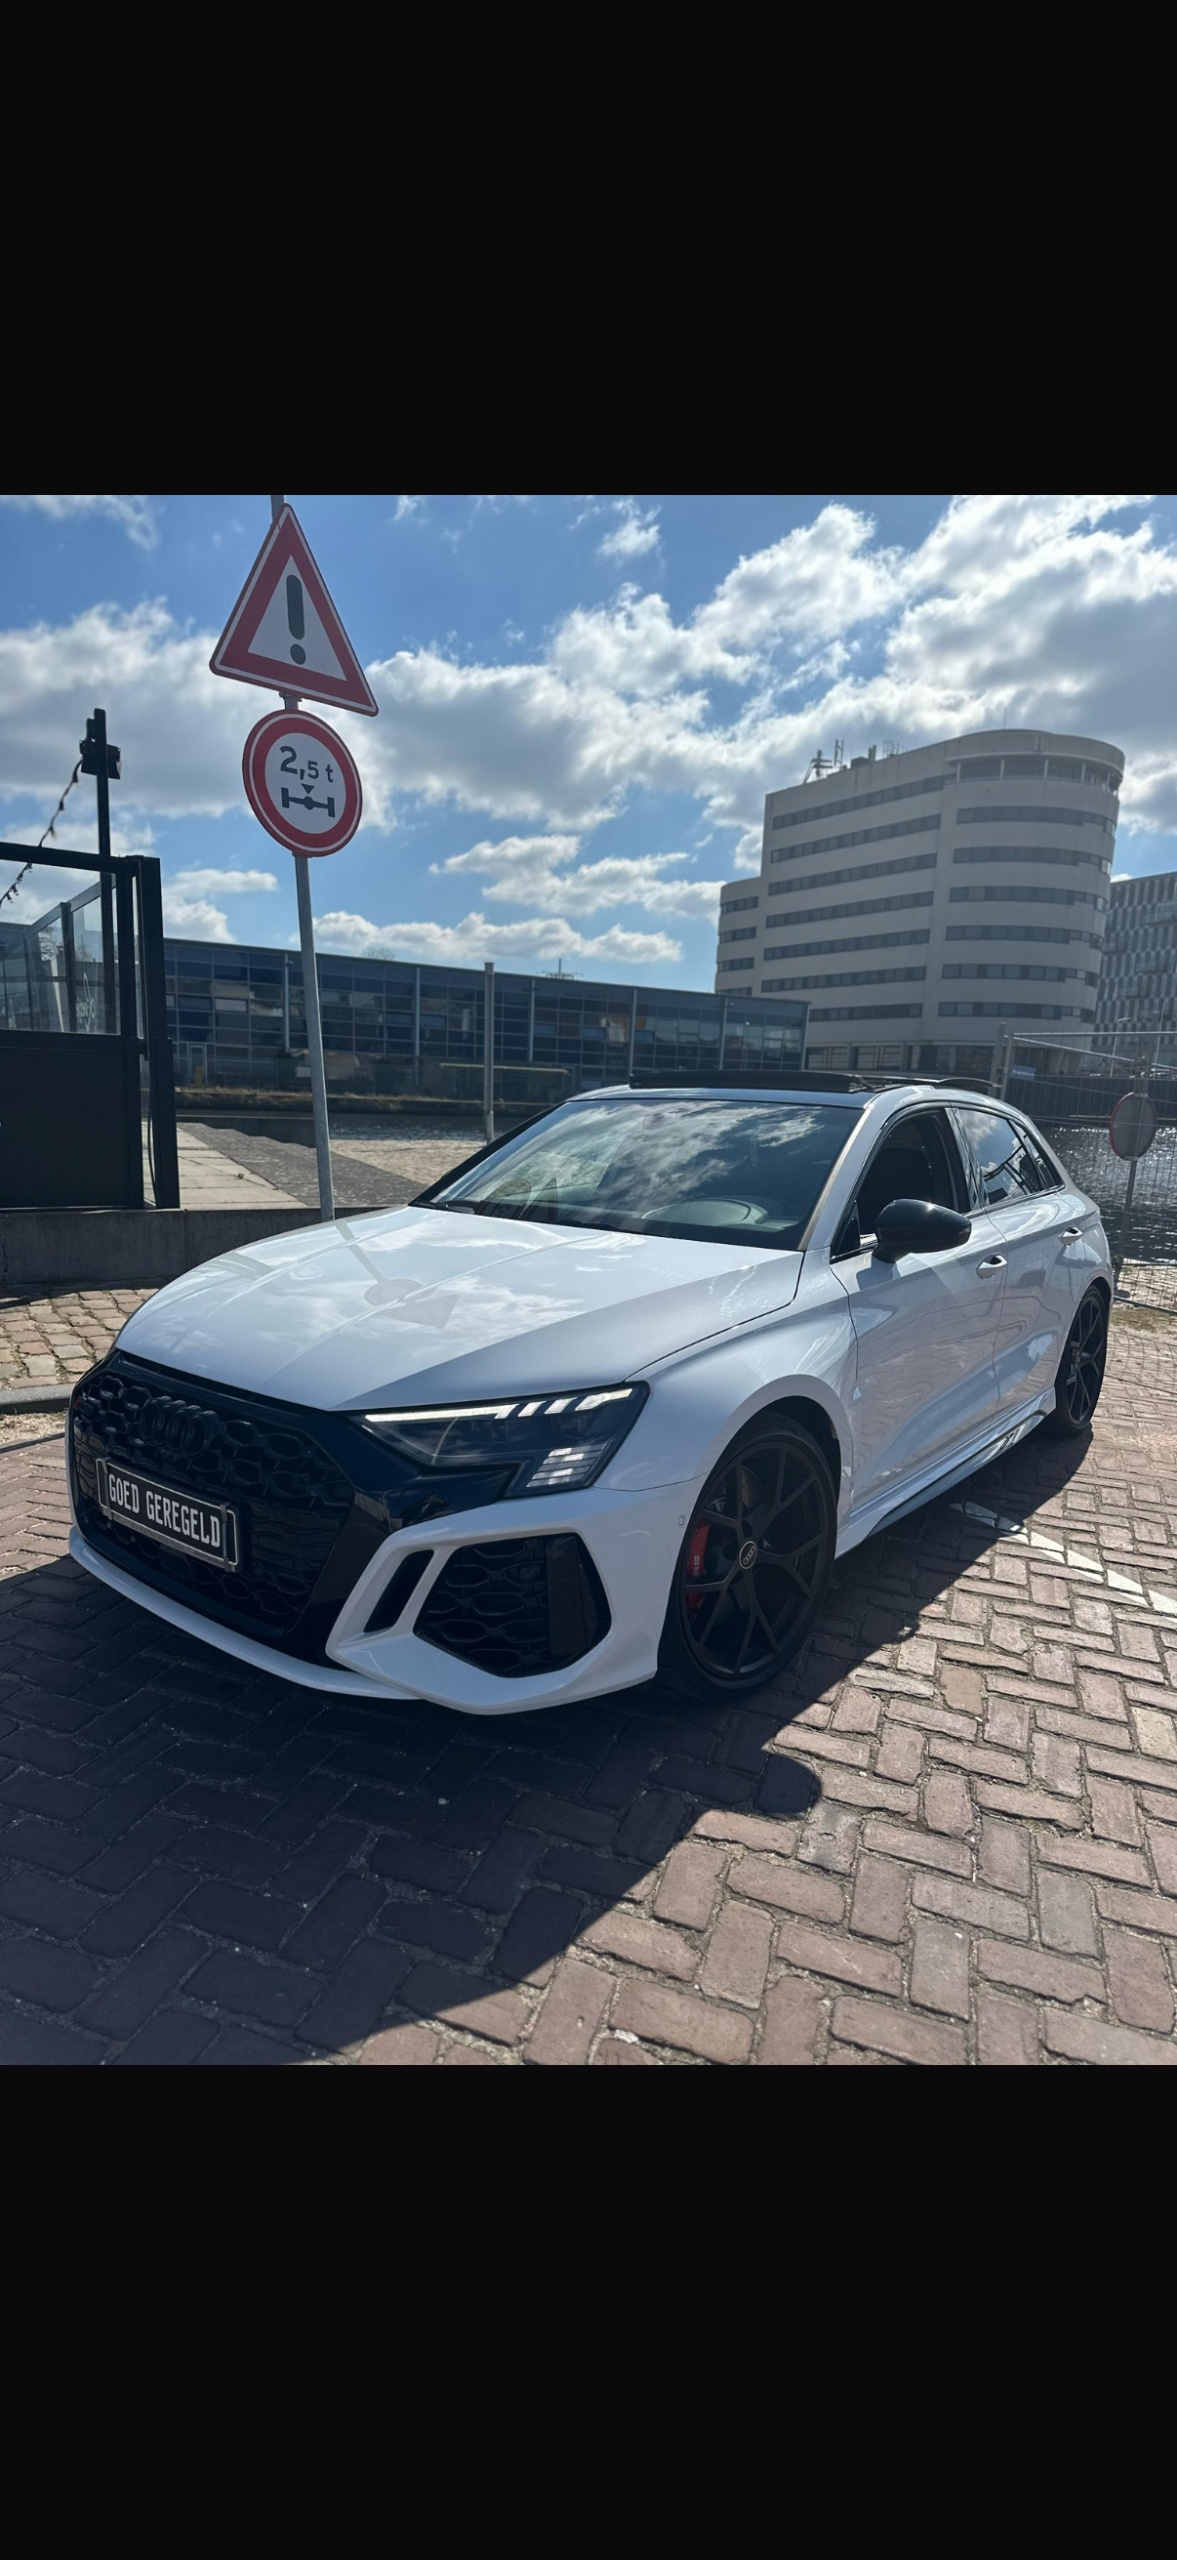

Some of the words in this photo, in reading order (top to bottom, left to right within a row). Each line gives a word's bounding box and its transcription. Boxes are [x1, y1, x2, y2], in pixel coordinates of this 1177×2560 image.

[279, 745, 319, 780] 2,5
[325, 764, 334, 783] t
[108, 1473, 140, 1514] GOED
[145, 1490, 221, 1548] GEREGELD
